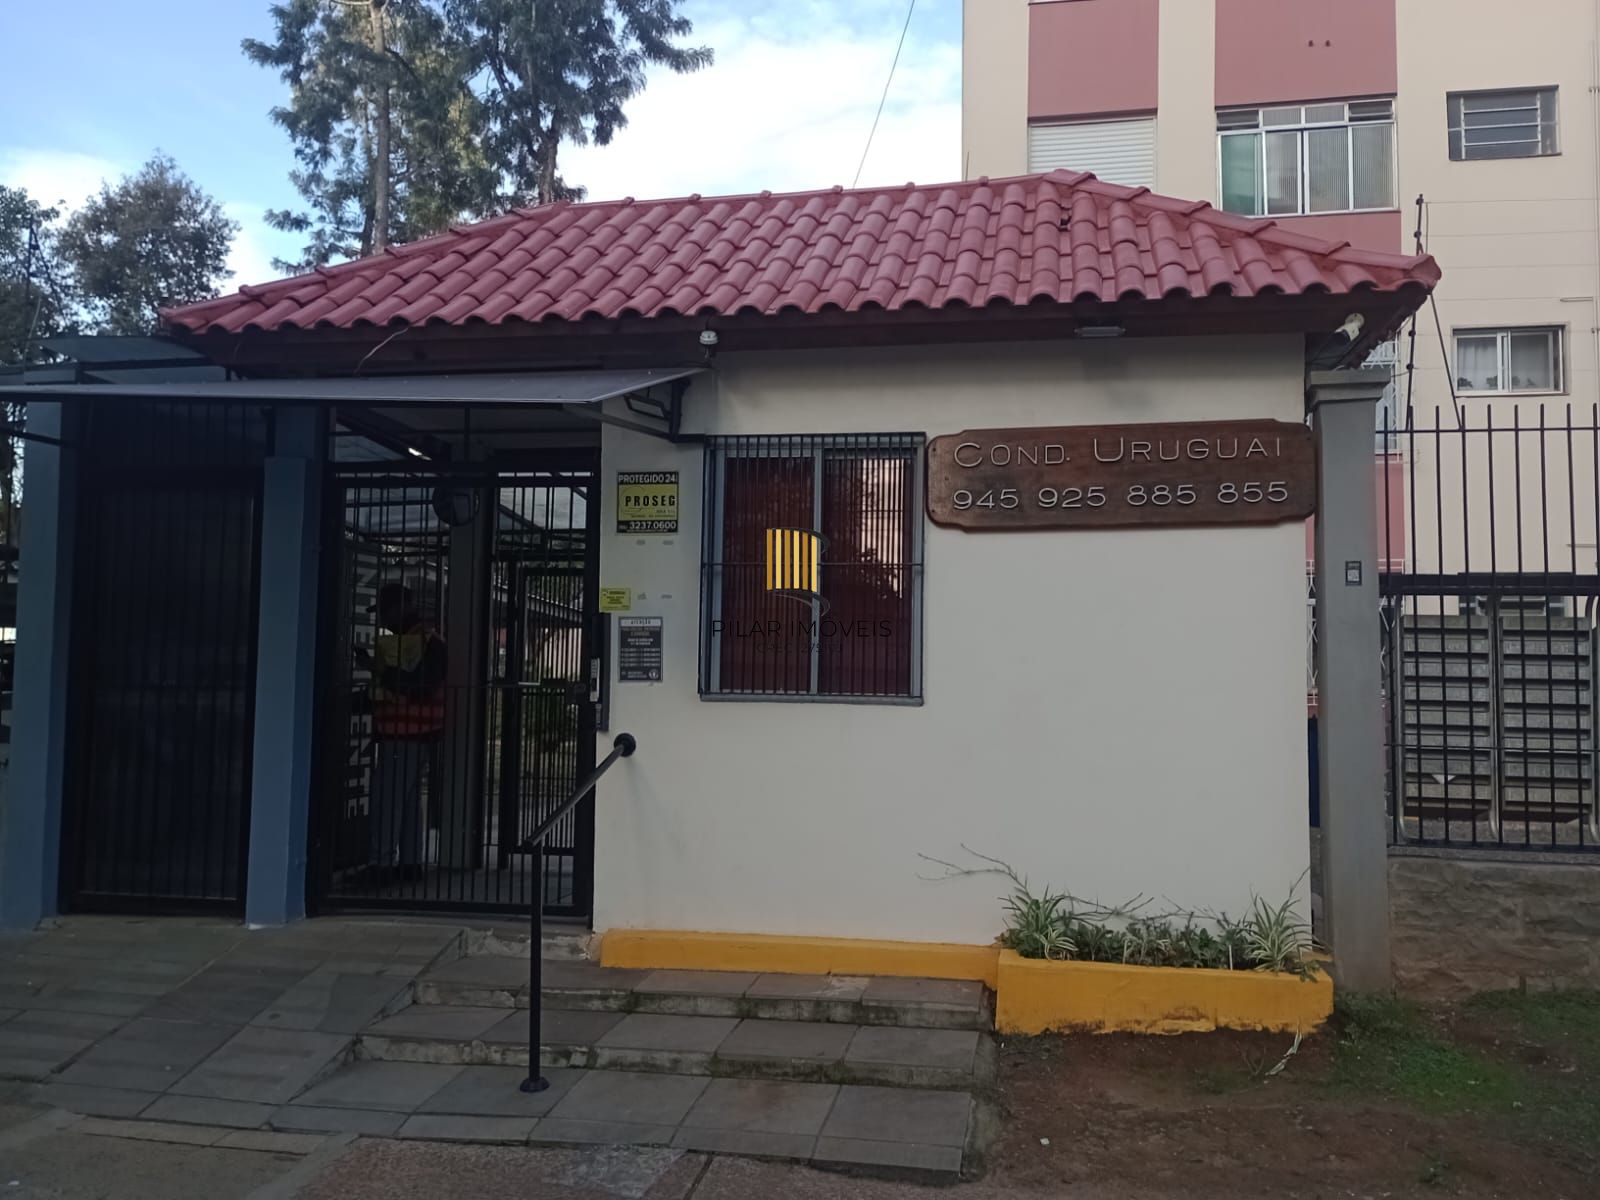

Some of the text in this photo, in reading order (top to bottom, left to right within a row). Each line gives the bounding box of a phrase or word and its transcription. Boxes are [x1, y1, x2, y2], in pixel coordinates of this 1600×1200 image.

[1094, 436, 1281, 462] URUGUAI
[618, 474, 664, 484] PROTEGIDO
[624, 495, 676, 507] PROSEG
[953, 481, 1289, 510] 945 925 885 855
